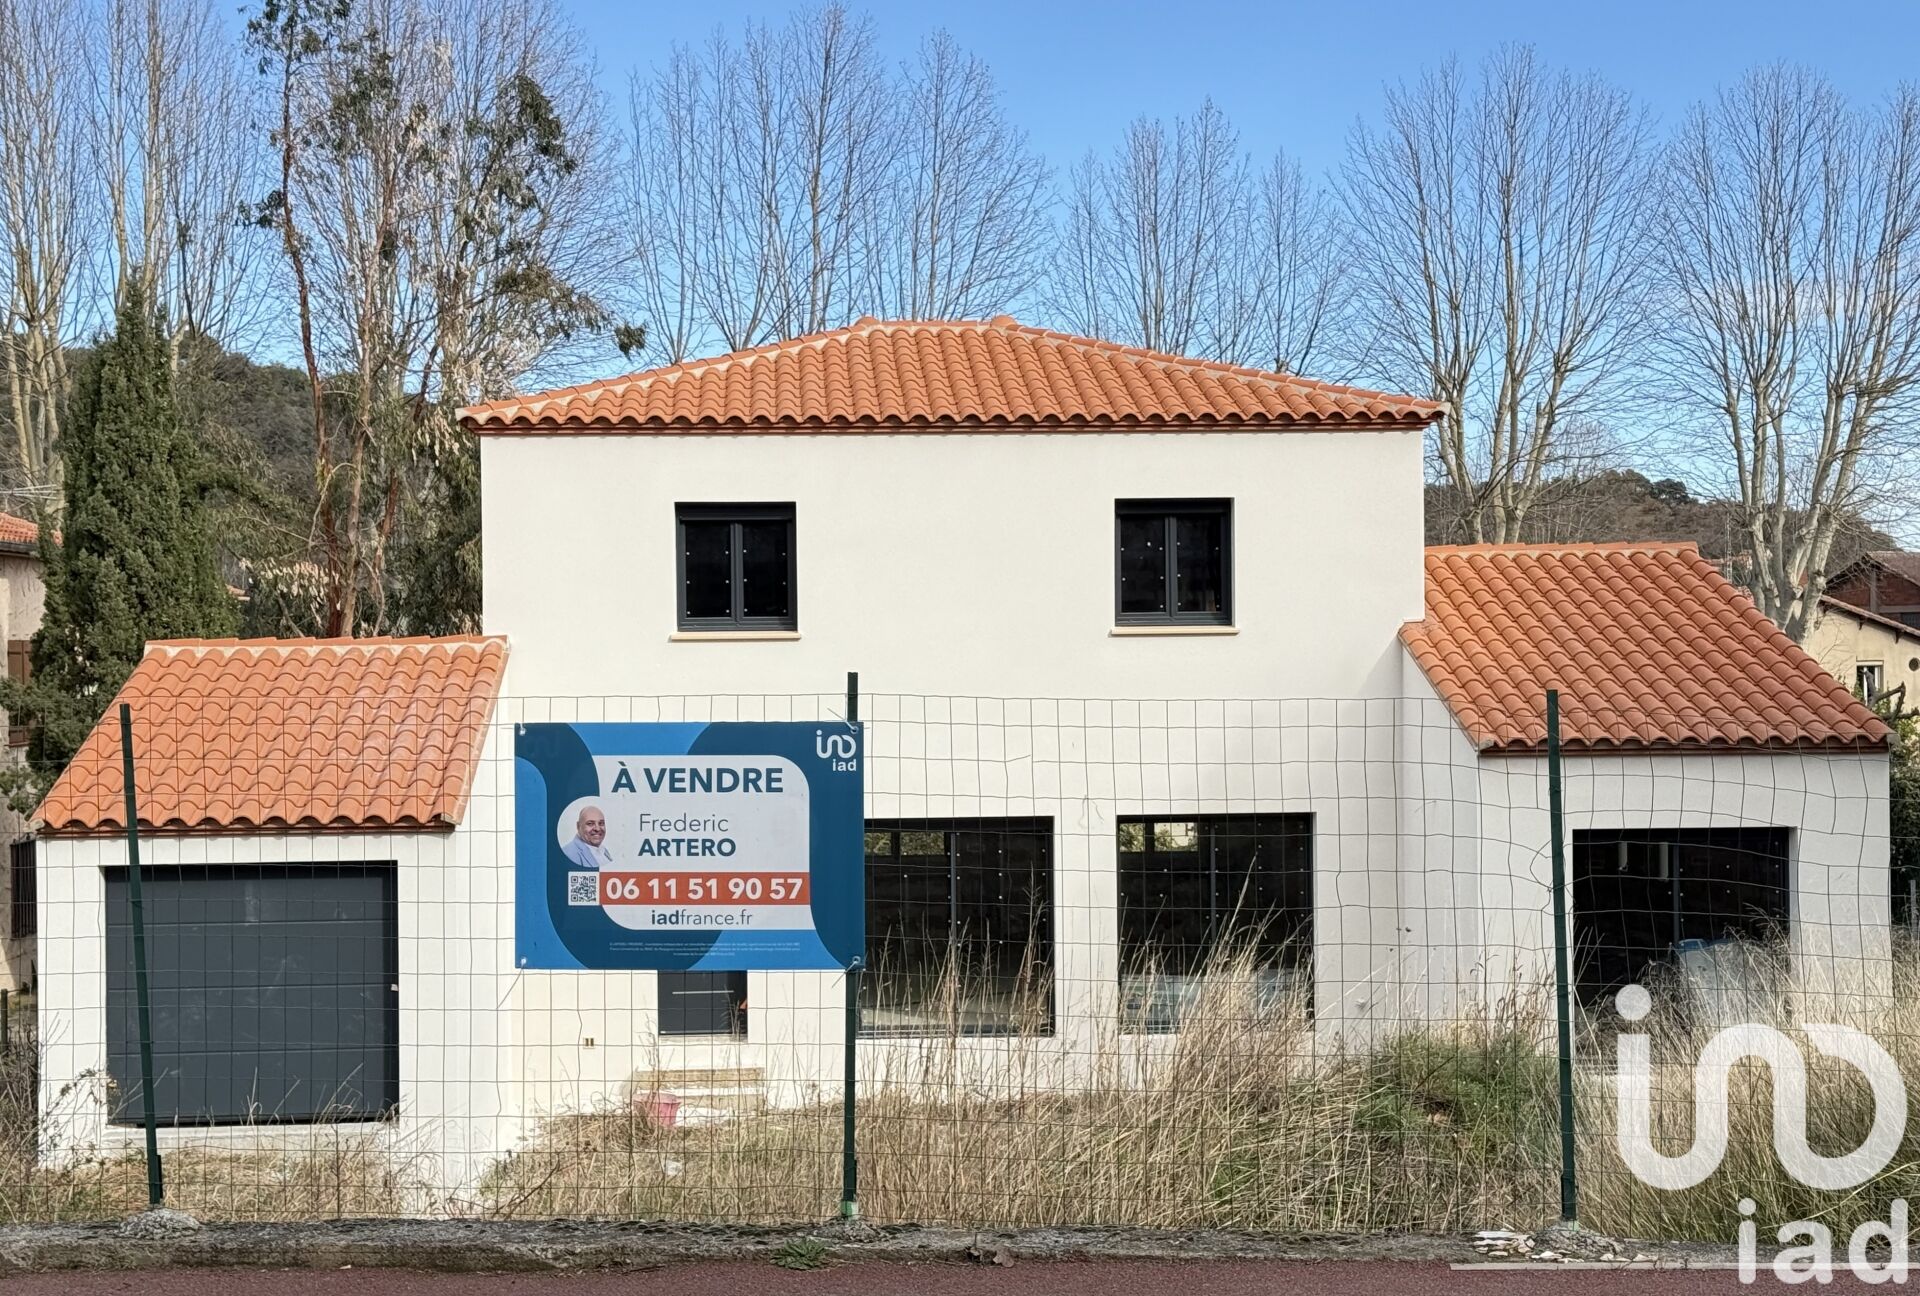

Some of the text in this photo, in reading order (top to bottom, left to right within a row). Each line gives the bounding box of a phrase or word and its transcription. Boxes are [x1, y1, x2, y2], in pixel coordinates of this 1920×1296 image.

[833, 759, 857, 771] iad
[611, 761, 784, 793] À VENDRE
[640, 813, 729, 832] Frederic
[638, 838, 736, 857] ARTERO
[606, 878, 803, 900] 06 11 51 90 57
[651, 909, 752, 926] iadfrance.fr
